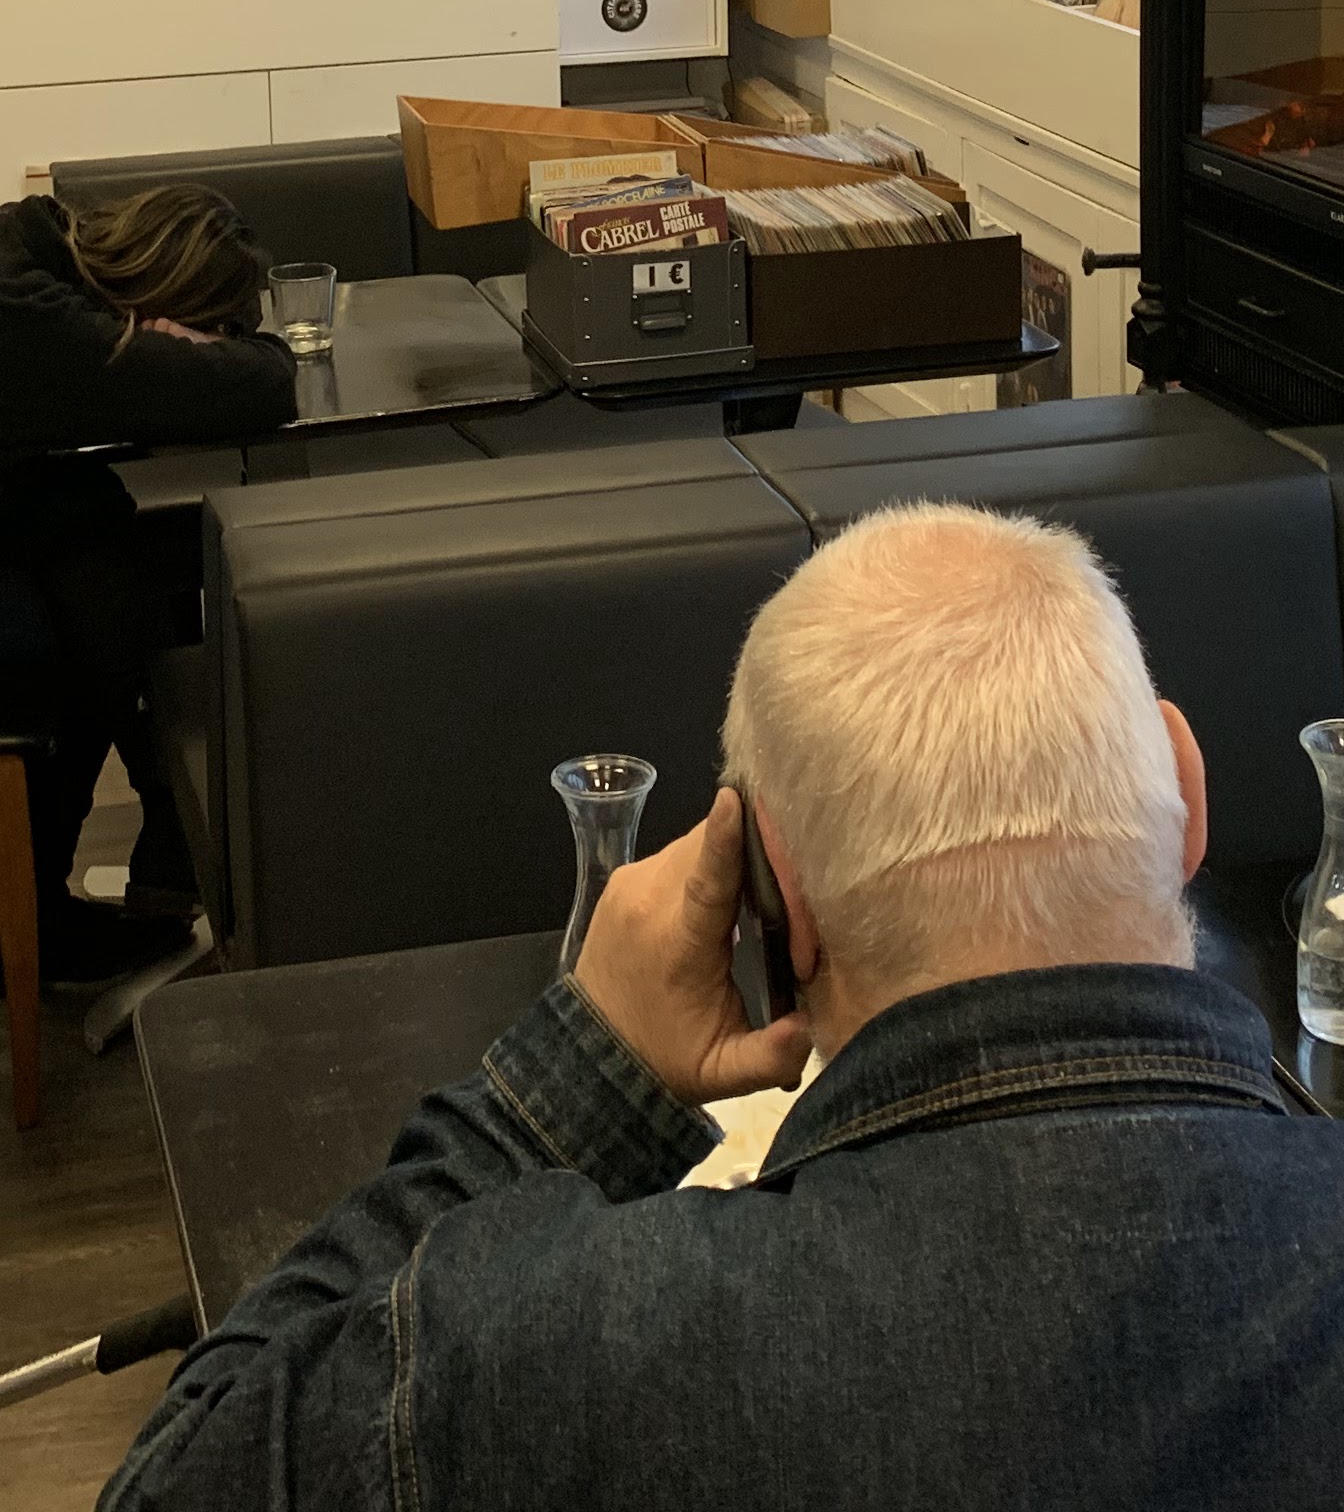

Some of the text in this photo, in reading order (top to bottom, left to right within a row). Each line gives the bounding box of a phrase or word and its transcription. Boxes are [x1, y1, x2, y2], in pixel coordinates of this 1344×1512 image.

[543, 157, 662, 182] LE PLOMBIER
[659, 201, 692, 221] CARTE
[663, 212, 706, 235] POSTALE
[580, 219, 660, 253] CABREL
[669, 263, 684, 284] €
